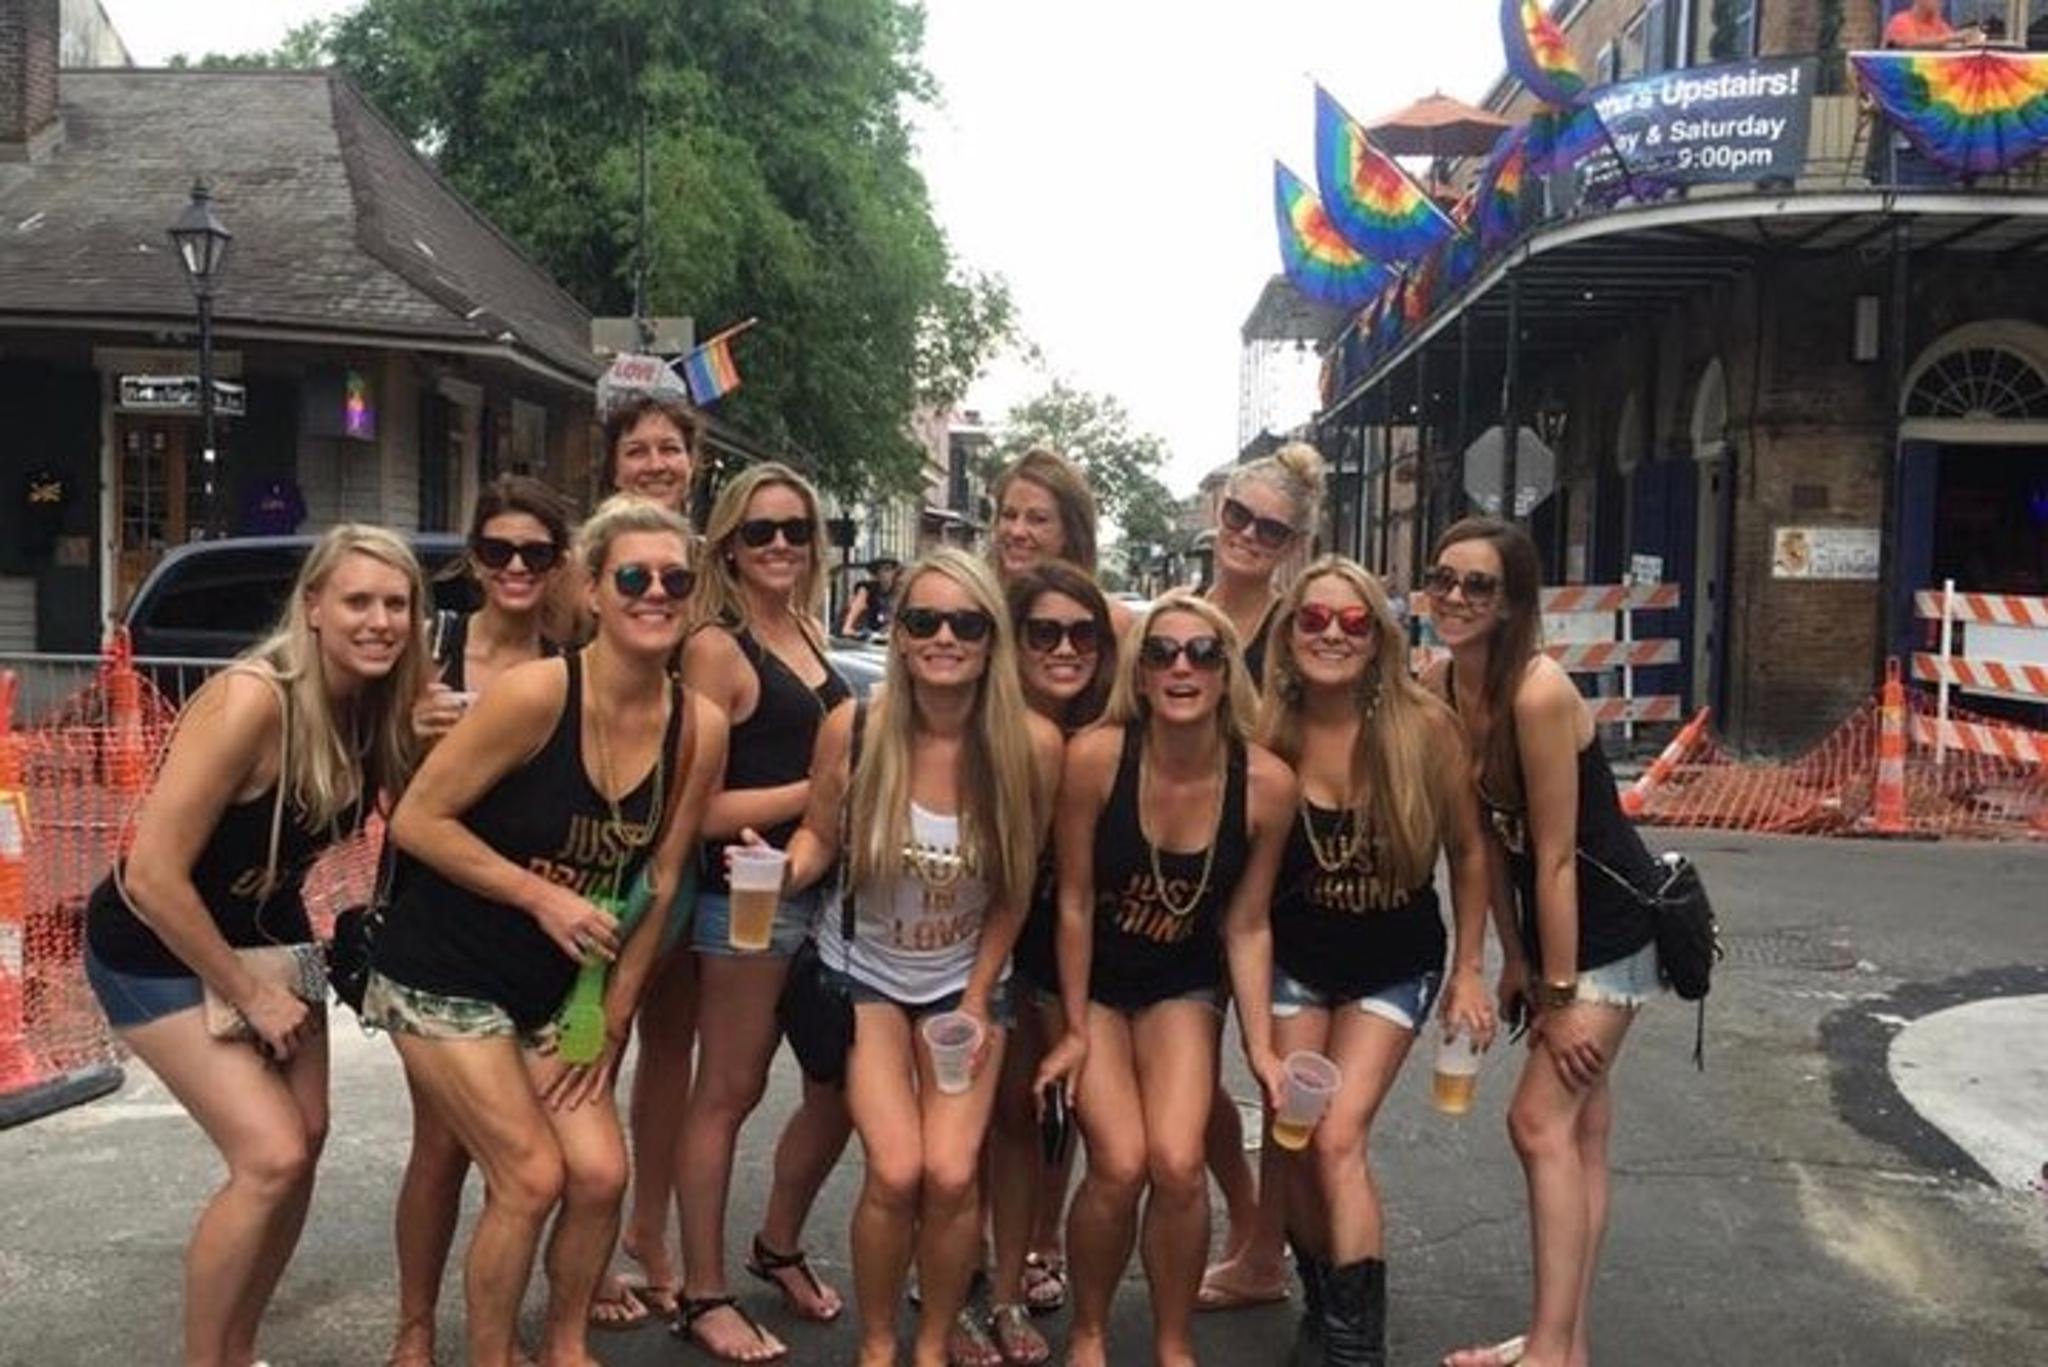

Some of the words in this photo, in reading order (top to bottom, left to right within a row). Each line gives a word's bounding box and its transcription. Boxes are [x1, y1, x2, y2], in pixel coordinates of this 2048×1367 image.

[1661, 68, 1799, 109] Upstairs!
[1645, 124, 1662, 145] &
[1669, 114, 1786, 143] Saturday
[1677, 146, 1773, 171] 9:00pm
